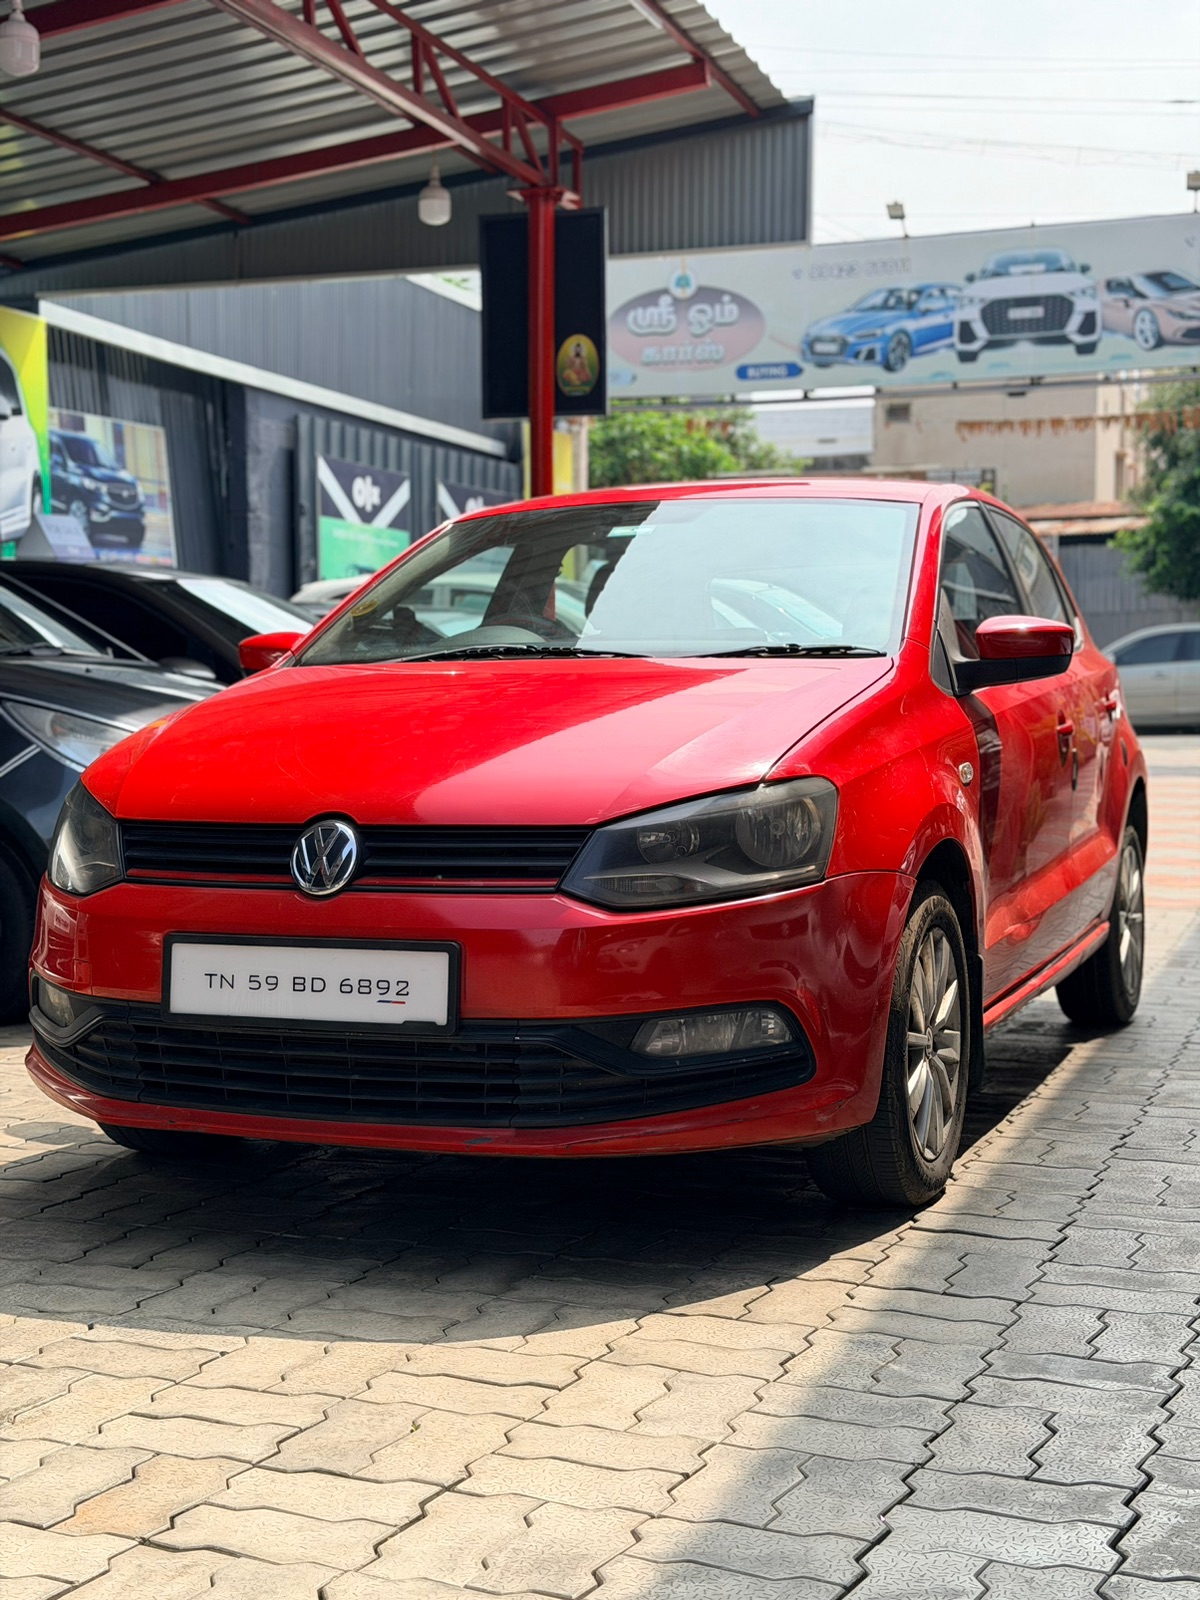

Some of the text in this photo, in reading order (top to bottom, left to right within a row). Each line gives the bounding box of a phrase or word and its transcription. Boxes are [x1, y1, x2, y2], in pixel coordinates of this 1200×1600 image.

[688, 294, 739, 337] ஓம்
[204, 973, 410, 996] TN 59 BD 6892
